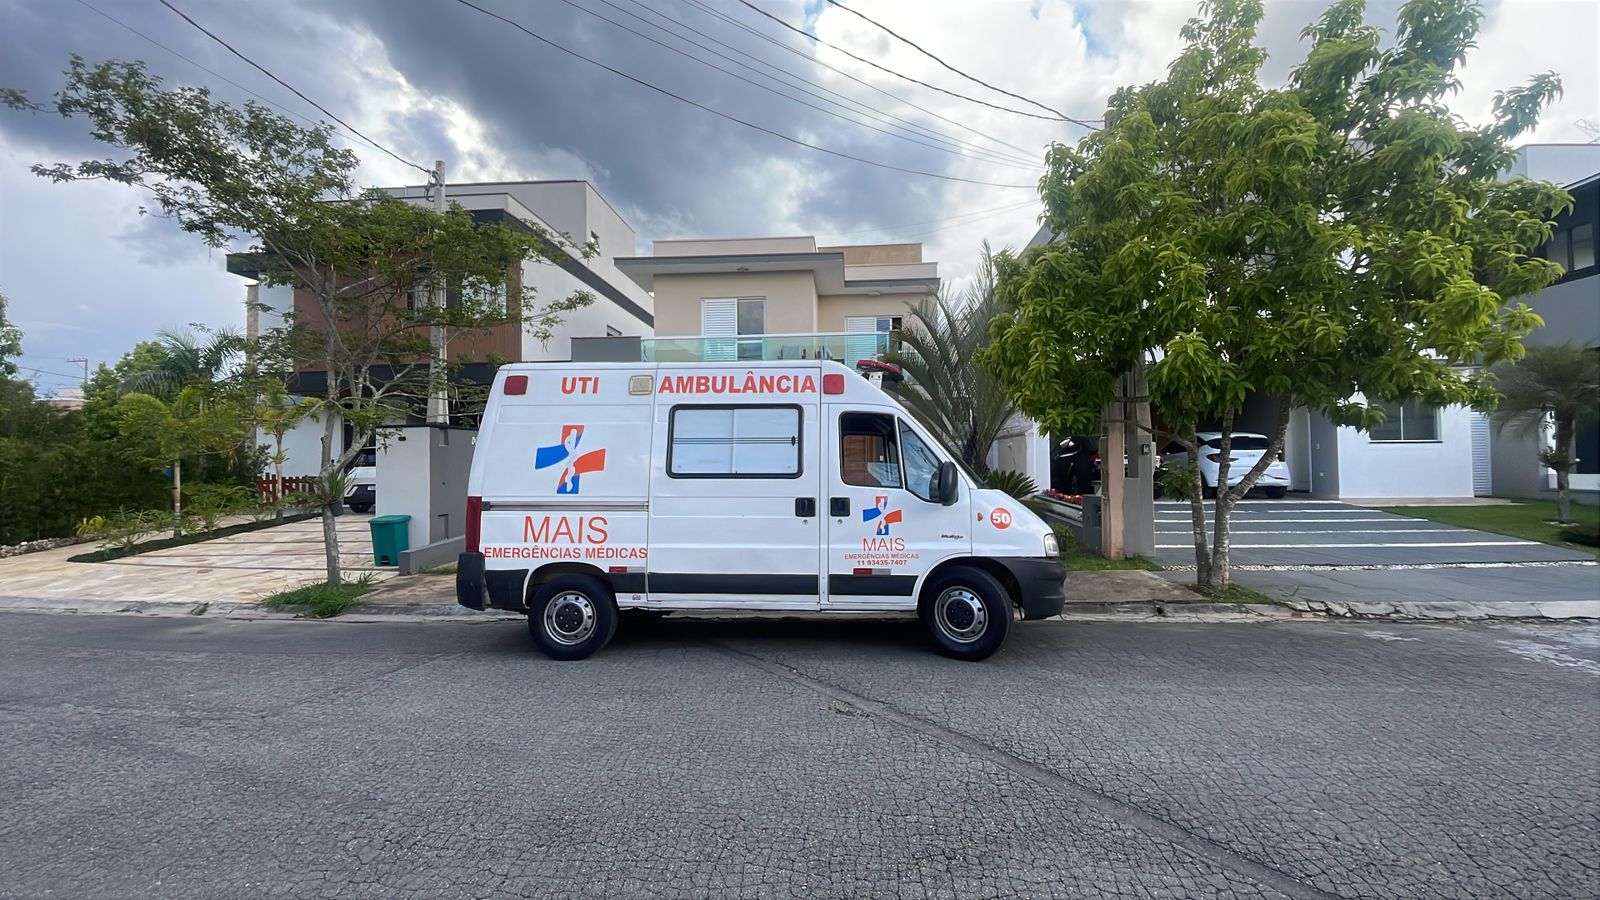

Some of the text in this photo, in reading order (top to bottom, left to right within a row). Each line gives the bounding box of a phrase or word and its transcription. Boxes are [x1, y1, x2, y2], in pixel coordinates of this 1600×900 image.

[561, 376, 599, 395] UTI
[658, 371, 817, 394] AMBULÂNCIA
[992, 512, 1010, 524] 50
[523, 516, 608, 544] MAIS
[863, 537, 905, 551] MAIS
[484, 546, 648, 559] EMERGÊNCIAS MÉDICAS
